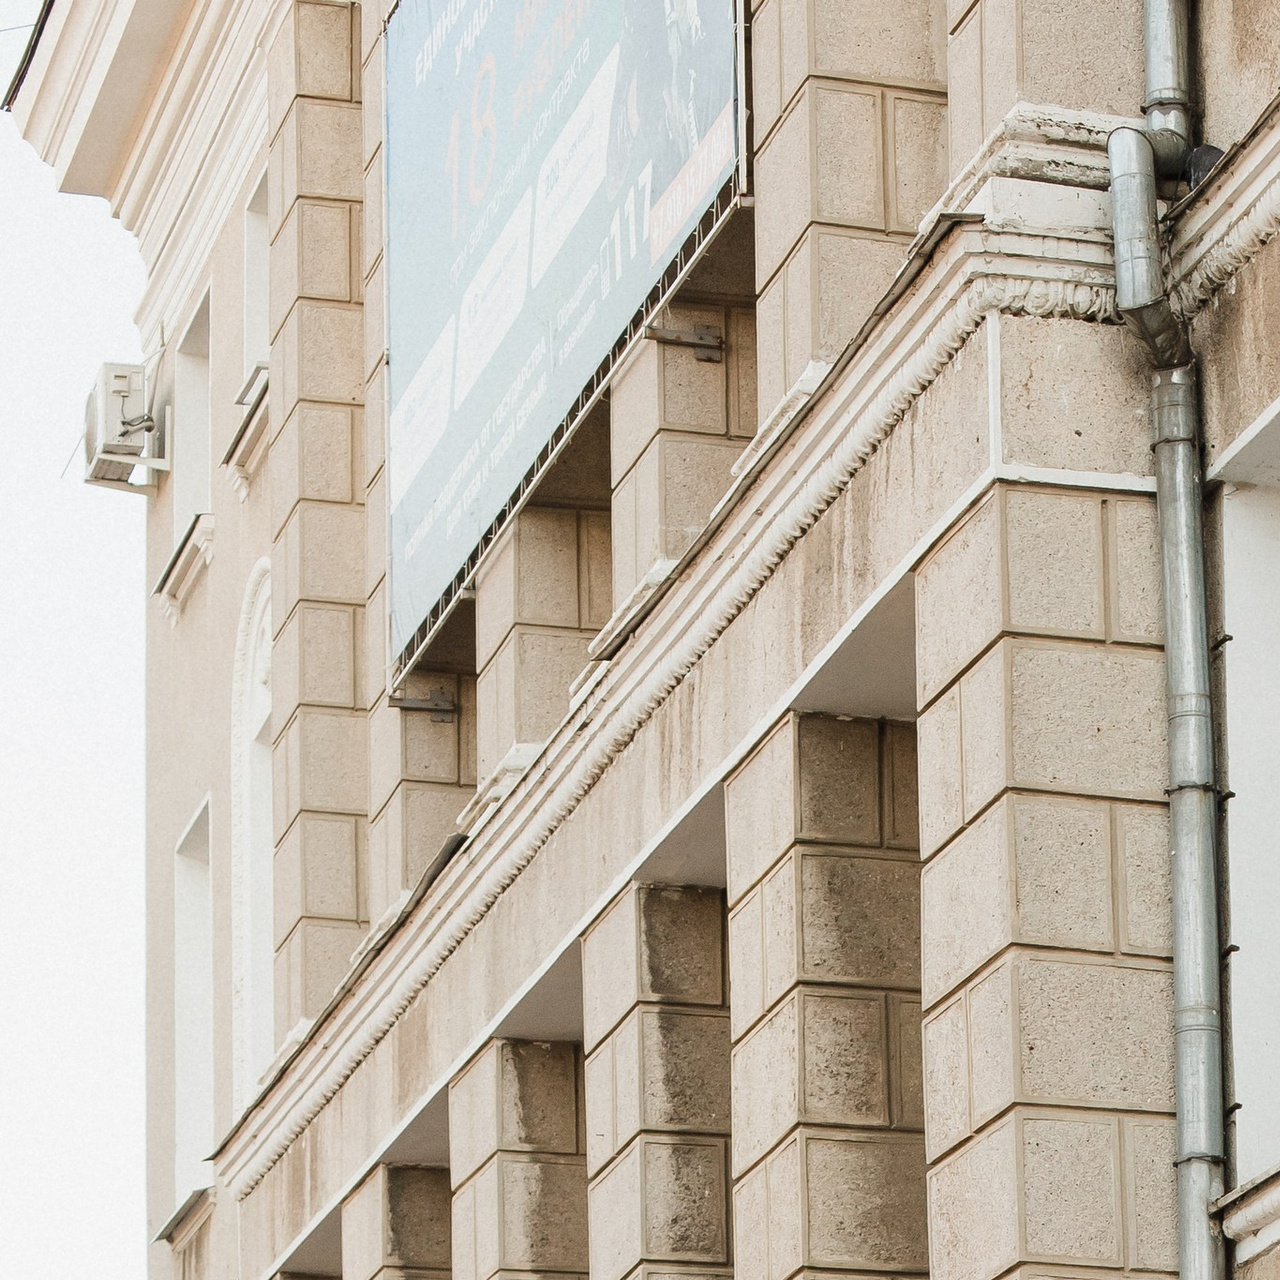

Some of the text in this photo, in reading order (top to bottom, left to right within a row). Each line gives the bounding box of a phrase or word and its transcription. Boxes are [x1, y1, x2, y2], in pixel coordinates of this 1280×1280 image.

[415, 0, 466, 88] ЕДИНО
[532, 37, 590, 149] контракта
[610, 158, 653, 281] 117
